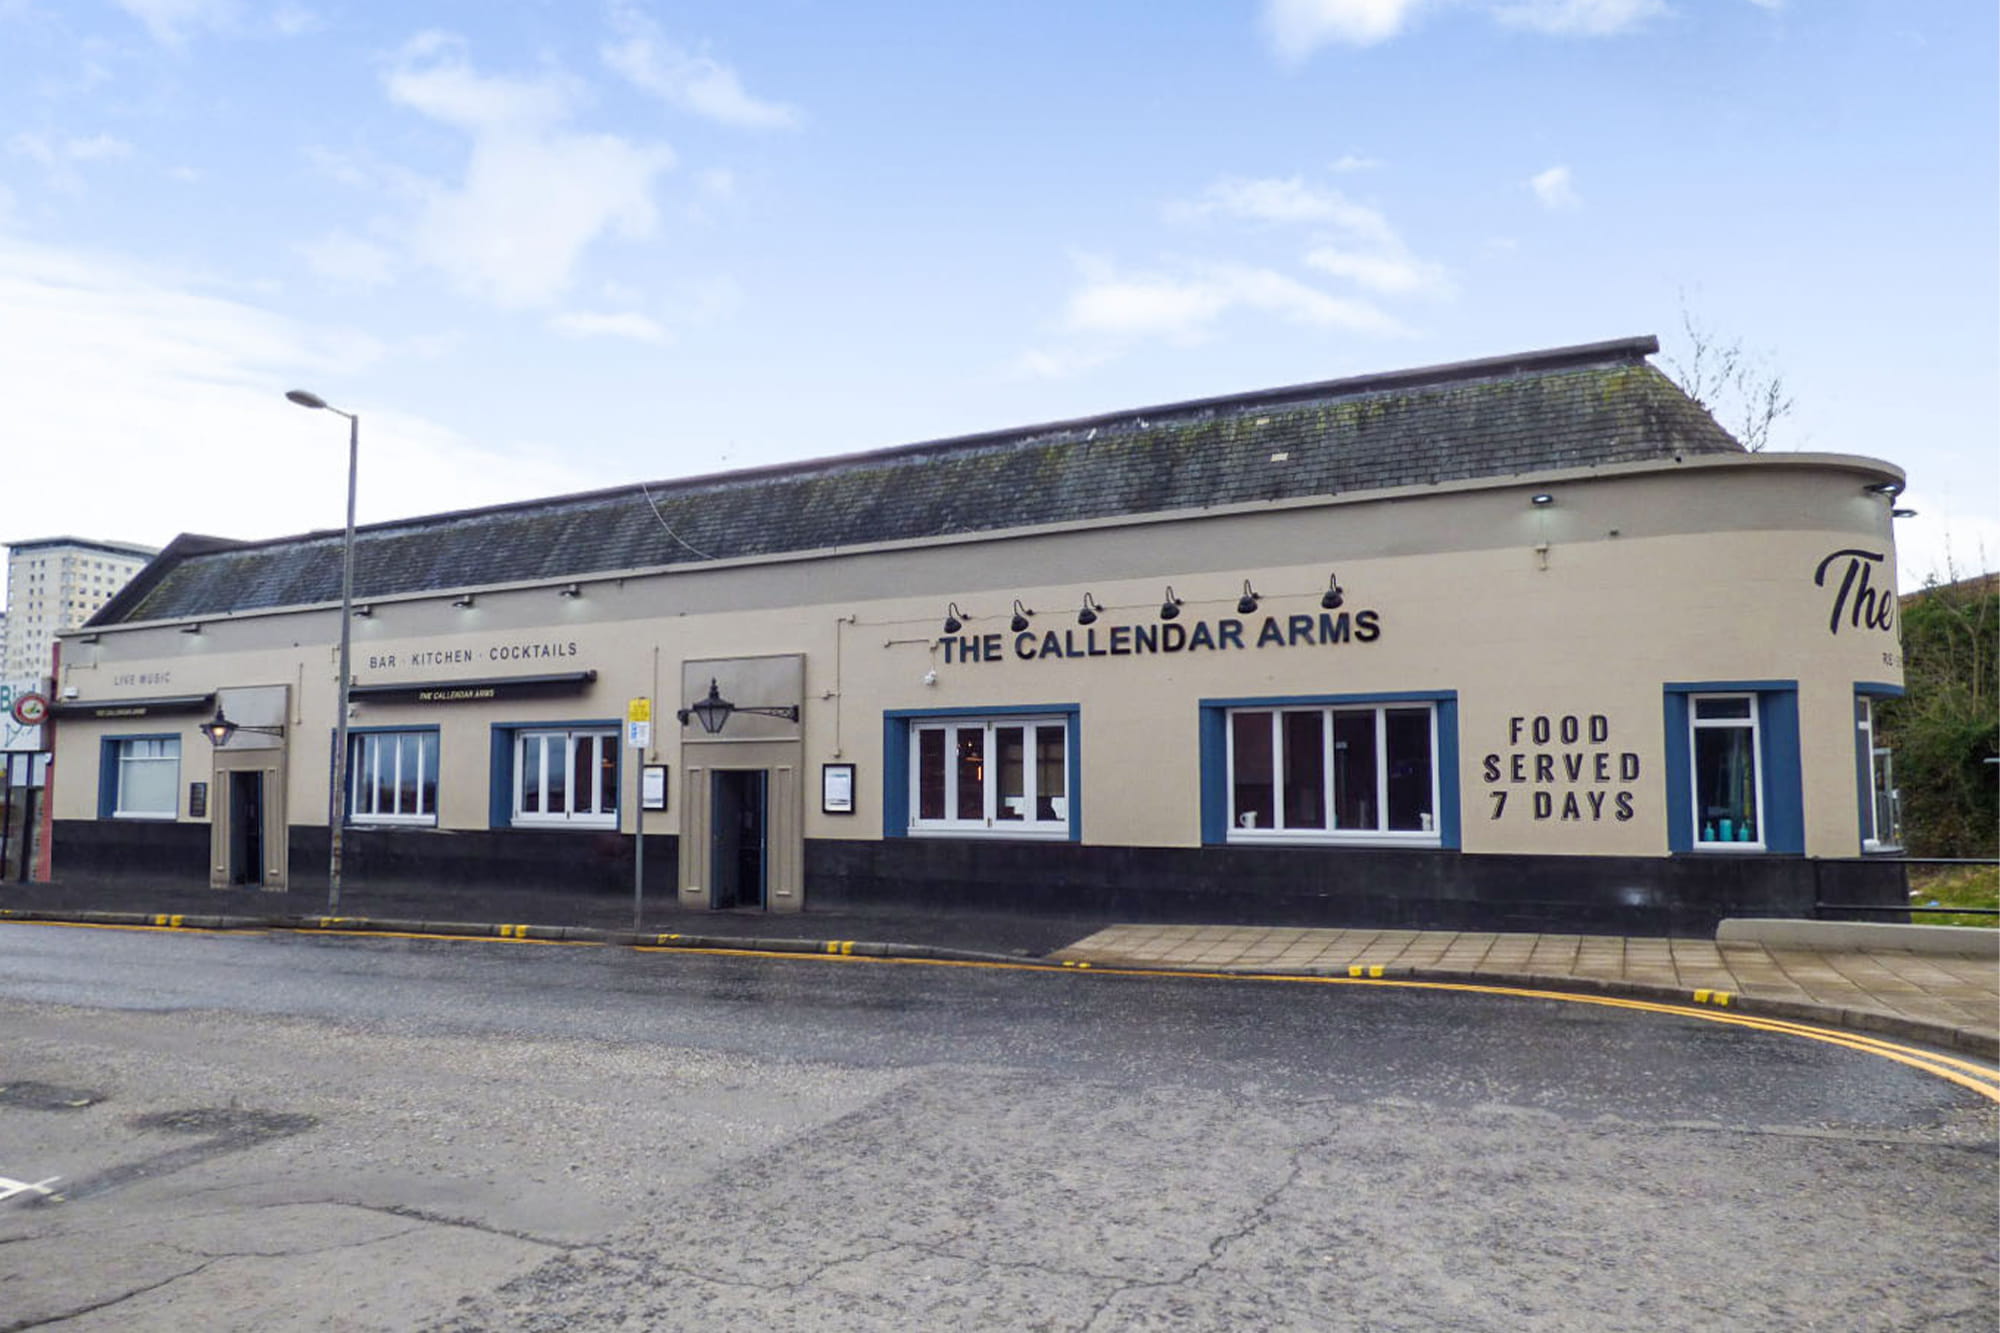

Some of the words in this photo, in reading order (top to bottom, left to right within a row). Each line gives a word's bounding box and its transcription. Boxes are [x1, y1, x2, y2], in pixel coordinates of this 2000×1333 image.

[1814, 549, 1894, 635] The
[938, 634, 1003, 664] THE
[1014, 619, 1246, 660] CALLENDAR
[1256, 610, 1382, 649] ARMS
[369, 655, 396, 669] BAR
[411, 649, 473, 665] KITCHEN
[489, 642, 577, 661] COCKTAILS
[113, 674, 136, 686] LIVE
[139, 671, 171, 685] MUSIC
[1509, 714, 1609, 746] FOOD
[1483, 752, 1641, 783] SERVED
[1489, 791, 1508, 821] 7
[1534, 791, 1635, 822] DAYS
